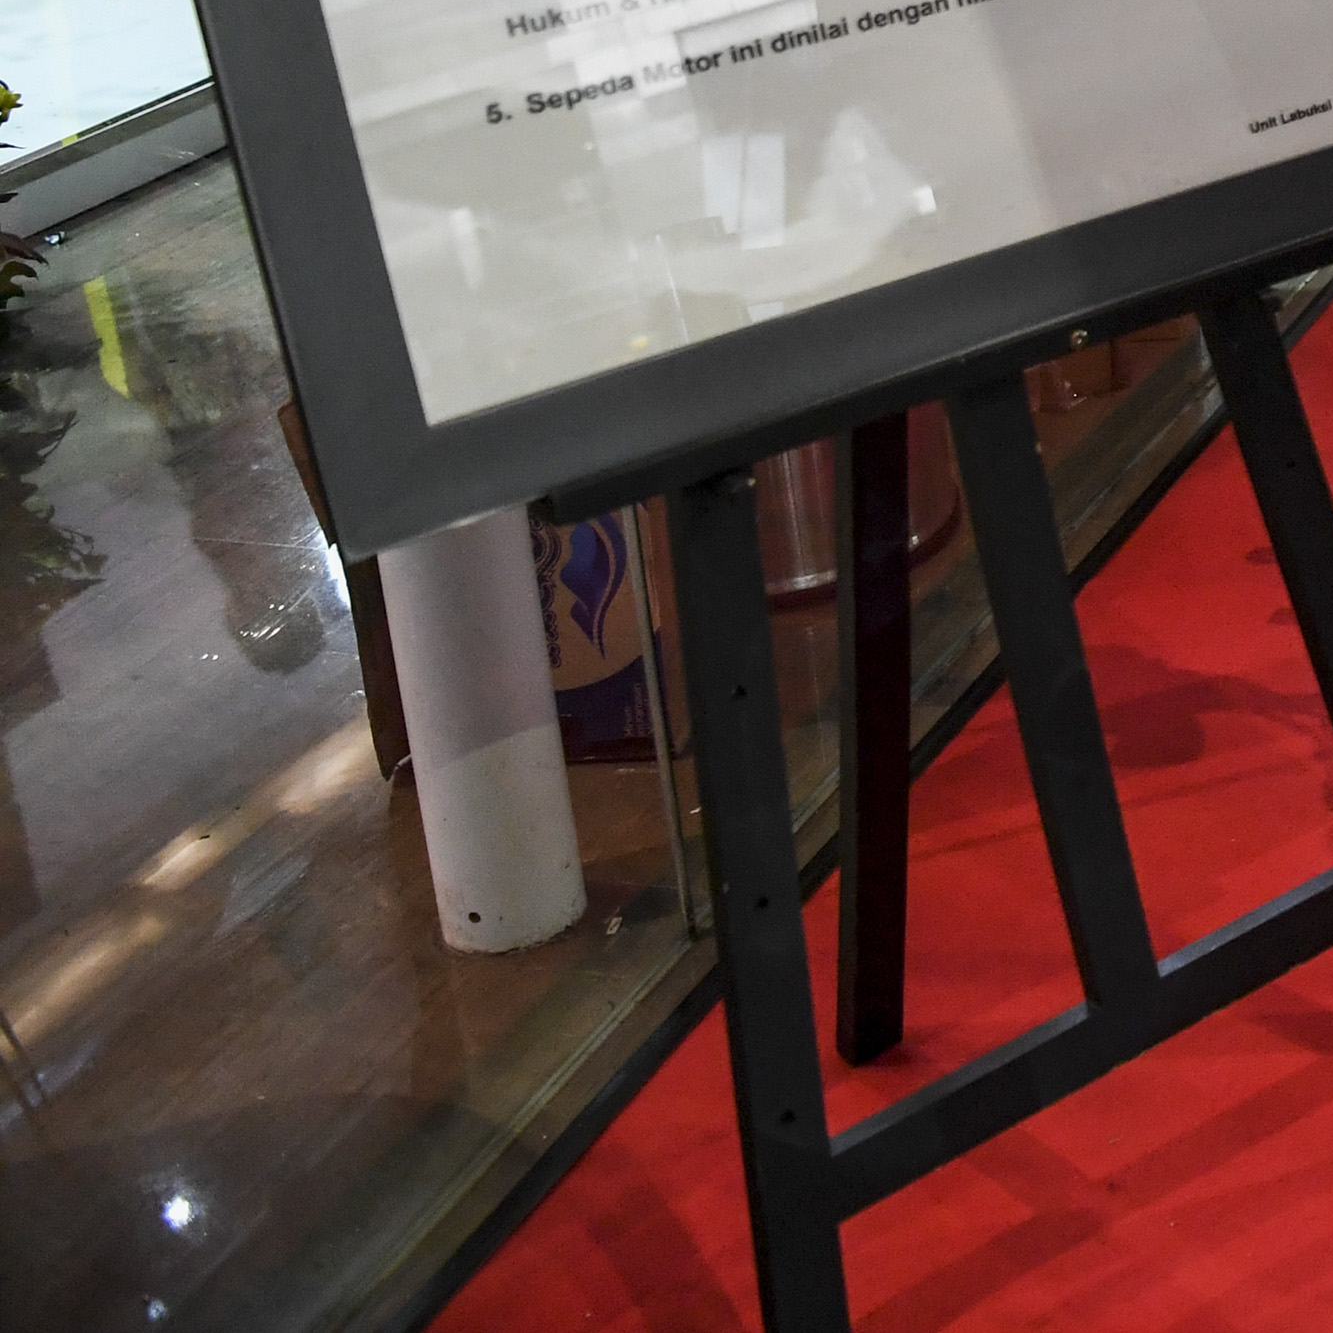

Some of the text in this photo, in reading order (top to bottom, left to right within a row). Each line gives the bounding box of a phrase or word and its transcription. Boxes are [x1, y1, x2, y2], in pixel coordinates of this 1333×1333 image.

[505, 2, 611, 37] Hukum
[484, 101, 513, 125] 5.
[525, 74, 635, 115] Sepeda
[729, 37, 765, 64] ini
[769, 16, 849, 54] dinilai
